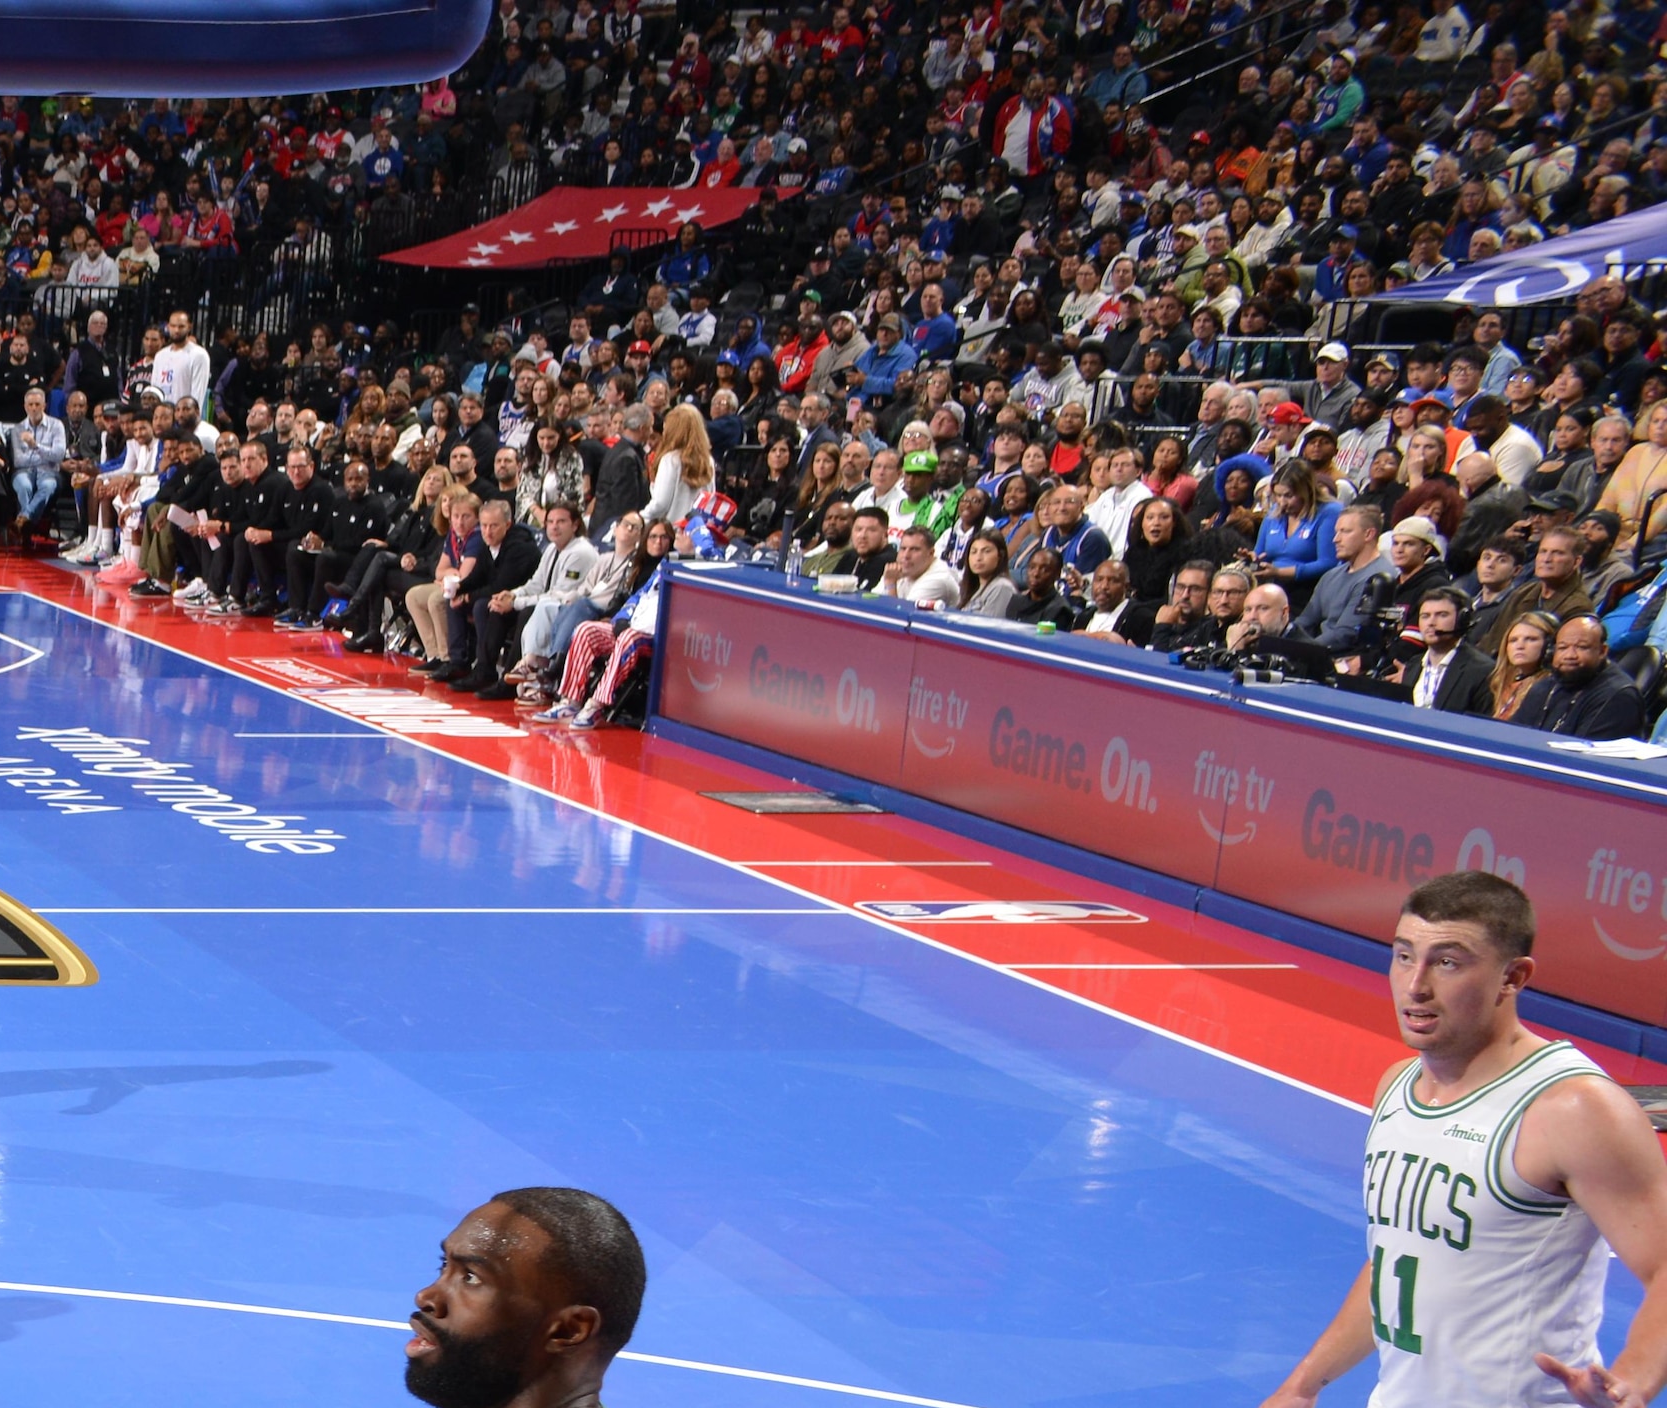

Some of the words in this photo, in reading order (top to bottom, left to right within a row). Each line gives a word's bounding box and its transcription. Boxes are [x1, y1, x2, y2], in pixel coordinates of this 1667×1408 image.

[160, 370, 174, 384] 76
[683, 622, 712, 663] fire
[715, 630, 732, 667] tv
[749, 645, 830, 718] Game.
[836, 666, 881, 734] On.
[909, 677, 942, 725] fire
[946, 689, 969, 730] tv
[16, 727, 194, 782] xfinity
[131, 784, 347, 854] mobile
[989, 705, 1092, 795] Game.
[1100, 736, 1158, 814] On.
[1193, 750, 1240, 806] fire
[1246, 766, 1275, 814] tv
[1302, 788, 1436, 890] Game
[1455, 828, 1526, 890] On
[1585, 847, 1653, 914] fire
[1443, 1123, 1487, 1144] Amica
[1372, 1244, 1423, 1356] 11
